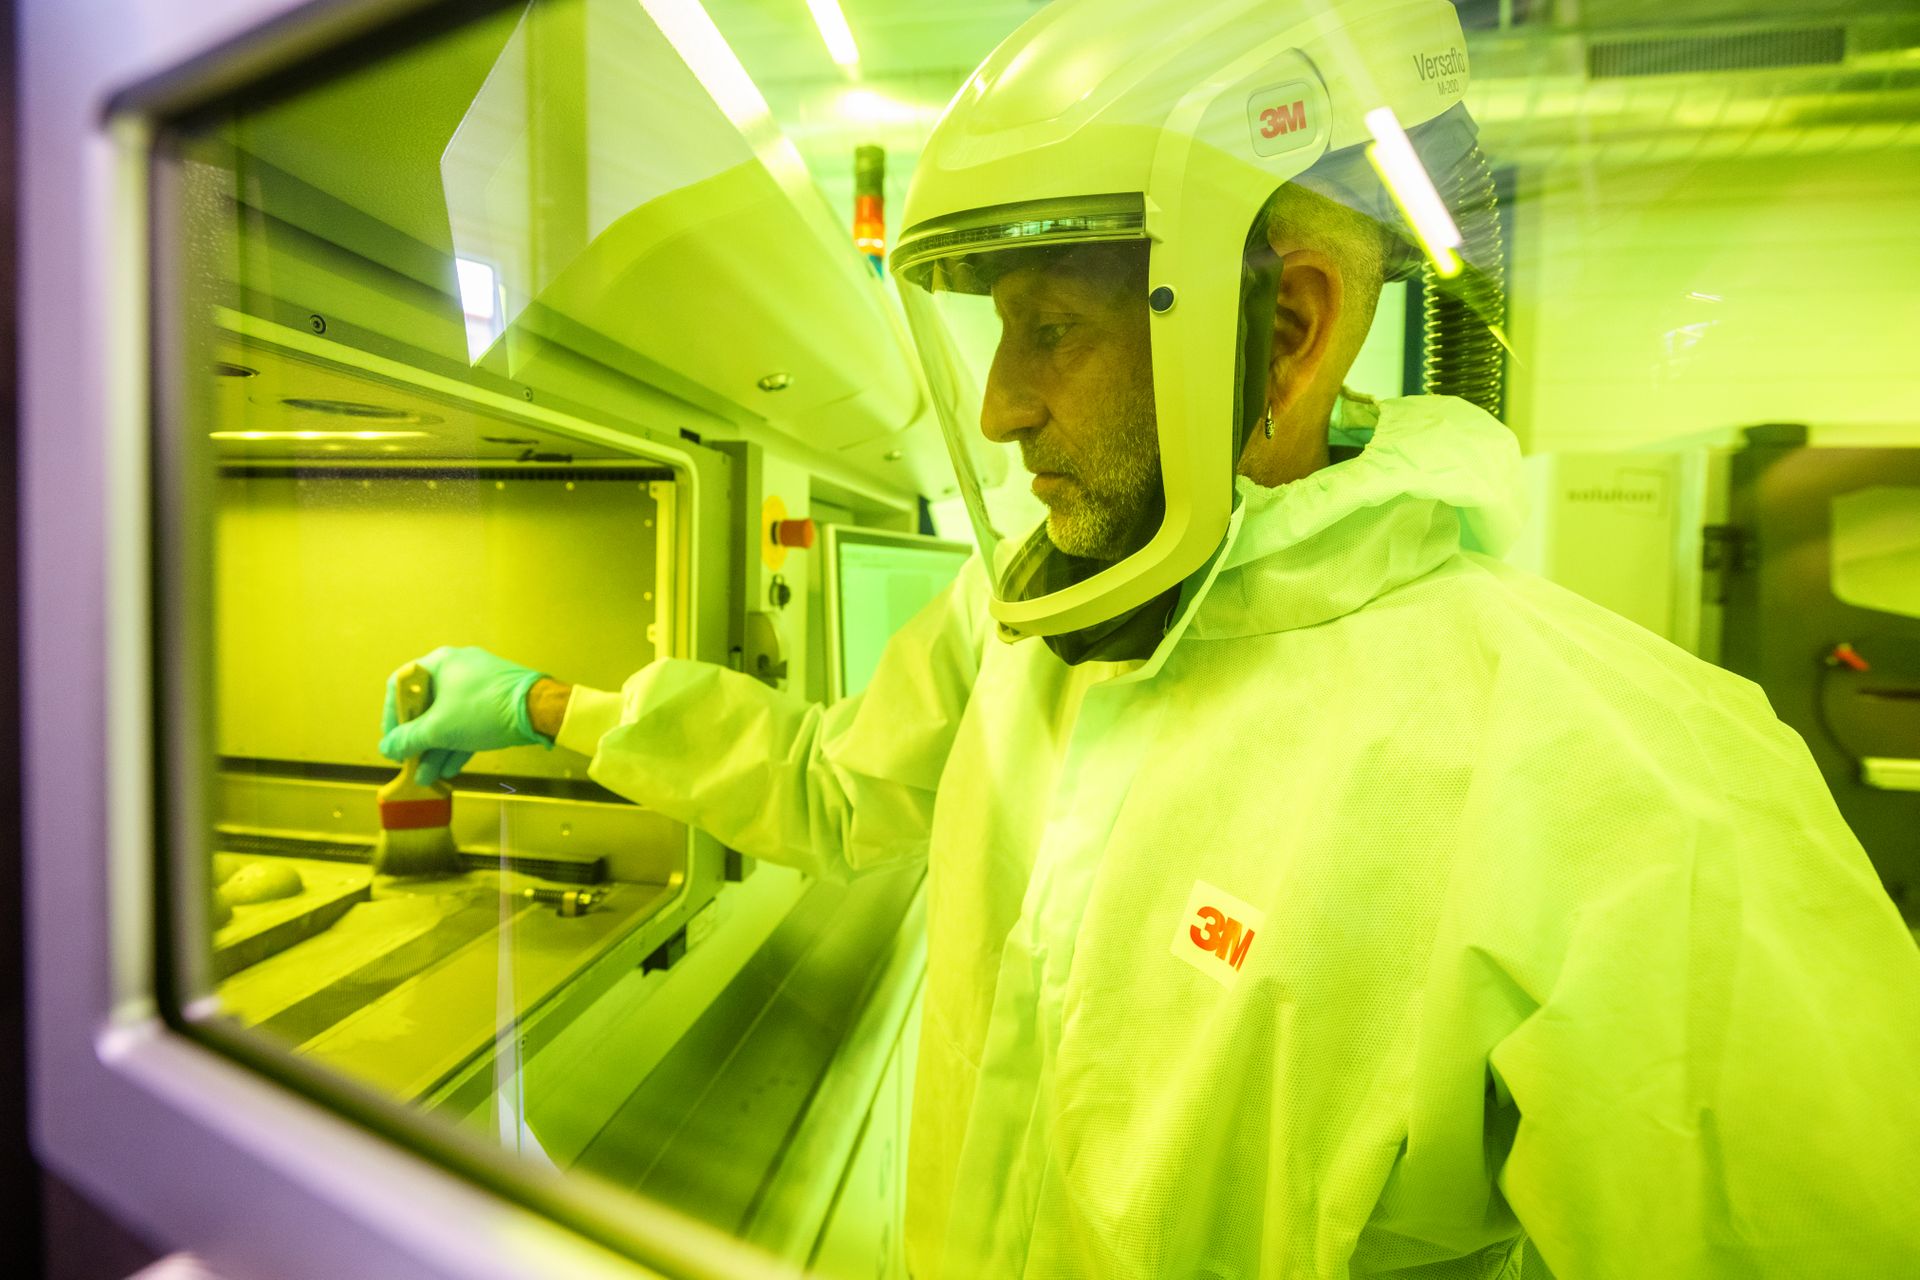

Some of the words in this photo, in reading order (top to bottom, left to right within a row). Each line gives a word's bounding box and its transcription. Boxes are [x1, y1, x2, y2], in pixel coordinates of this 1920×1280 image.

[1413, 47, 1466, 80] Versaflo
[1437, 79, 1459, 96] M-200
[1260, 100, 1307, 139] 3M
[1190, 906, 1255, 972] 3M
